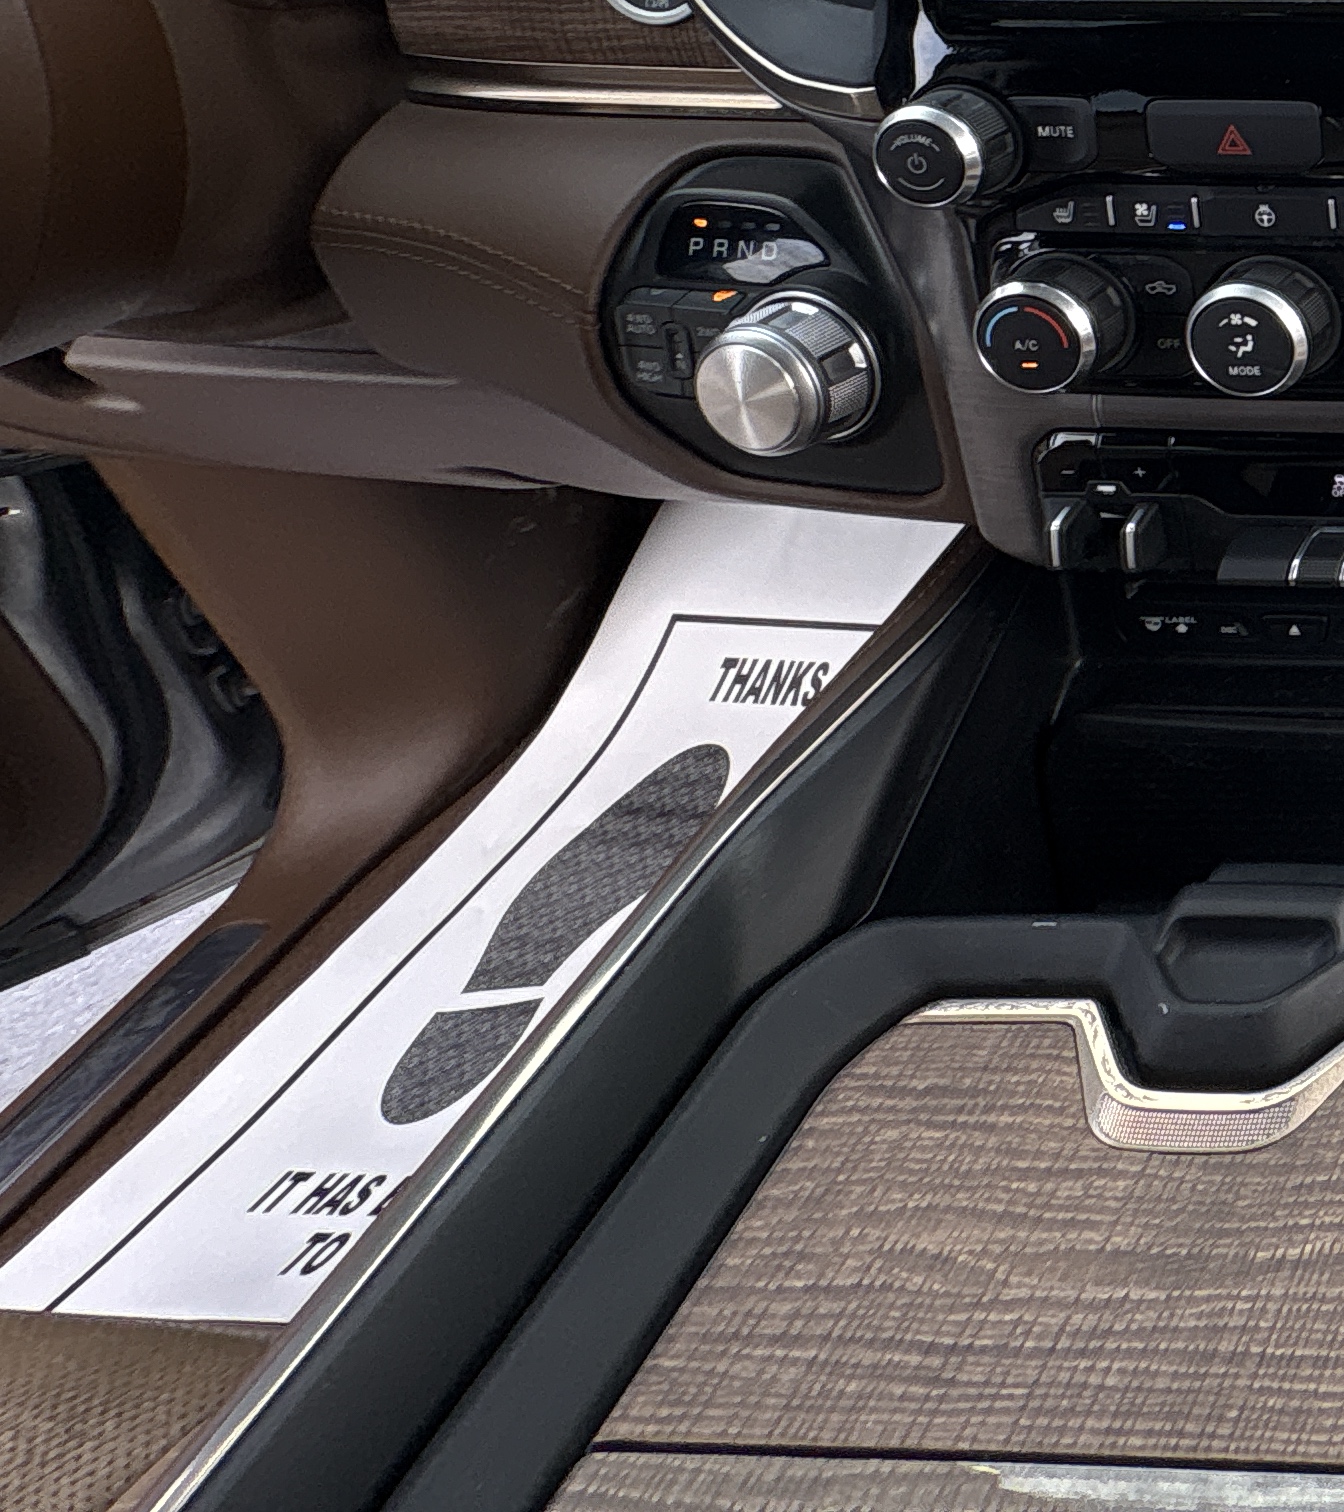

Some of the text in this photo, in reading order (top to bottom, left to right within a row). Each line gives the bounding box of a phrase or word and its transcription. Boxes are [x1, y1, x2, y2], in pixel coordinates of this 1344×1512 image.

[1037, 126, 1075, 138] MUTE
[895, 133, 933, 148] VOLUME
[688, 237, 779, 261] P R N D
[1014, 338, 1040, 353] A/C
[1157, 338, 1181, 351] OFF
[1228, 365, 1262, 378] MODE
[1165, 616, 1197, 624] LABEL
[709, 657, 830, 706] THANKS
[247, 1170, 316, 1213] IT
[289, 1172, 387, 1216] HAS
[277, 1232, 351, 1276] TO
